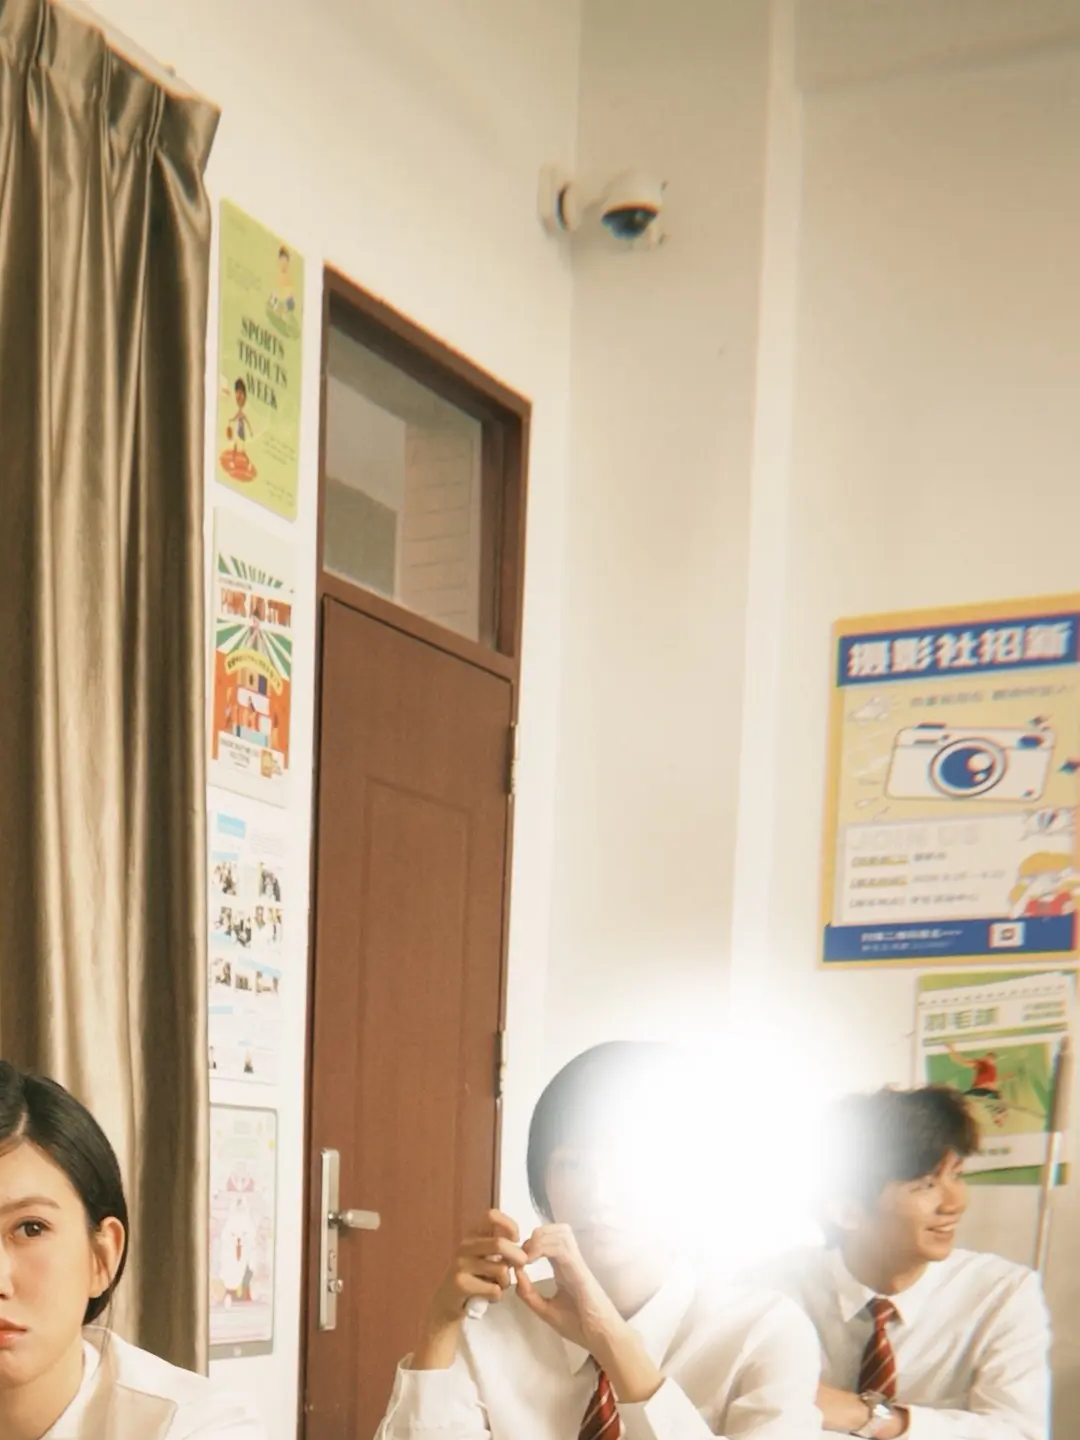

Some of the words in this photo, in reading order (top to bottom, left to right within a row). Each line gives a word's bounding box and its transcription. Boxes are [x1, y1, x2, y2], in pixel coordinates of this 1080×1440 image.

[241, 316, 285, 360] SPORTS
[237, 338, 288, 389] TRYOUTS
[245, 371, 277, 411] WEEK
[847, 621, 1072, 678] 摄影社招新
